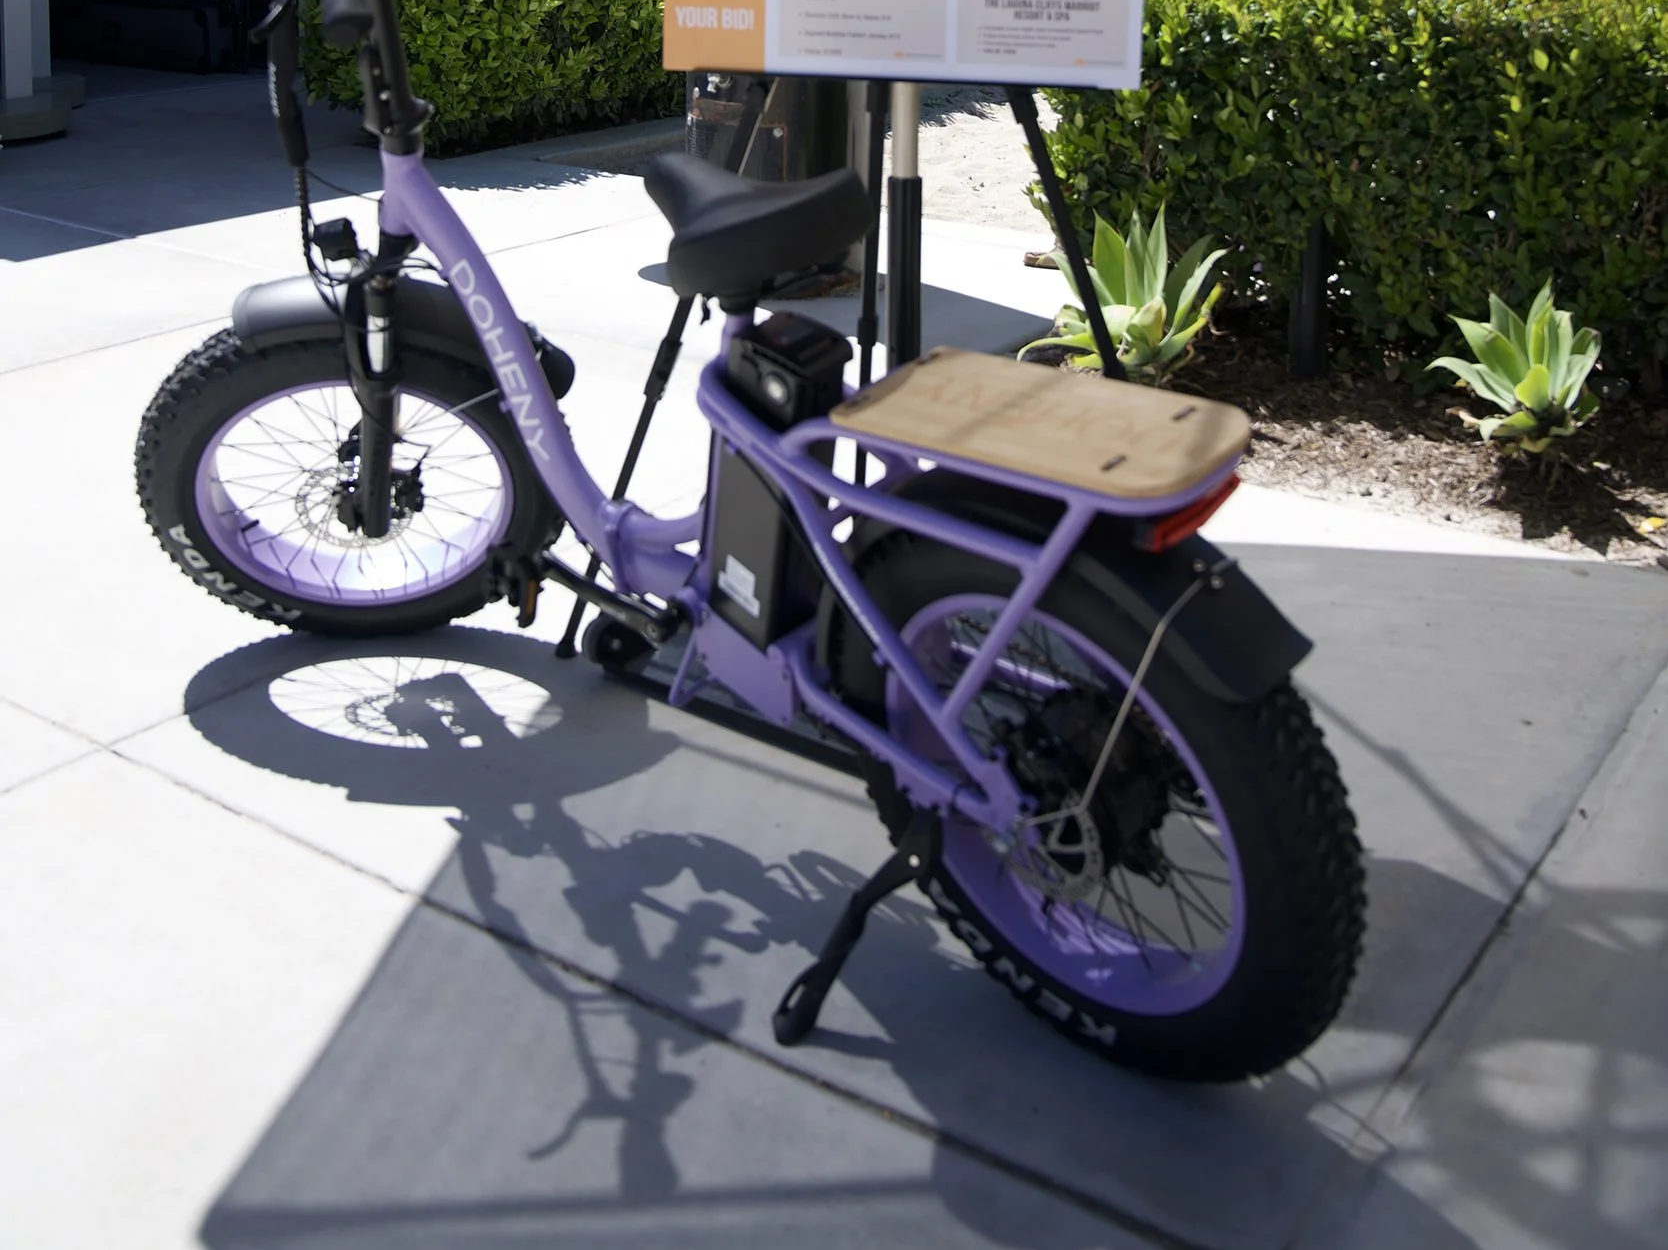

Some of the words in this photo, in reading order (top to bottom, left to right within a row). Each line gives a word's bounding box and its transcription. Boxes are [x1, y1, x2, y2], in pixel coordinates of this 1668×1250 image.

[675, 5, 718, 28] YOUR
[721, 7, 755, 30] BID!
[1014, 10, 1044, 21] RESORT
[1054, 11, 1070, 21] SPA
[1035, 0, 1062, 10] CLIFFS
[449, 259, 550, 462] DOHENY
[168, 524, 302, 621] KENDA
[928, 877, 1118, 1047] KENDA
